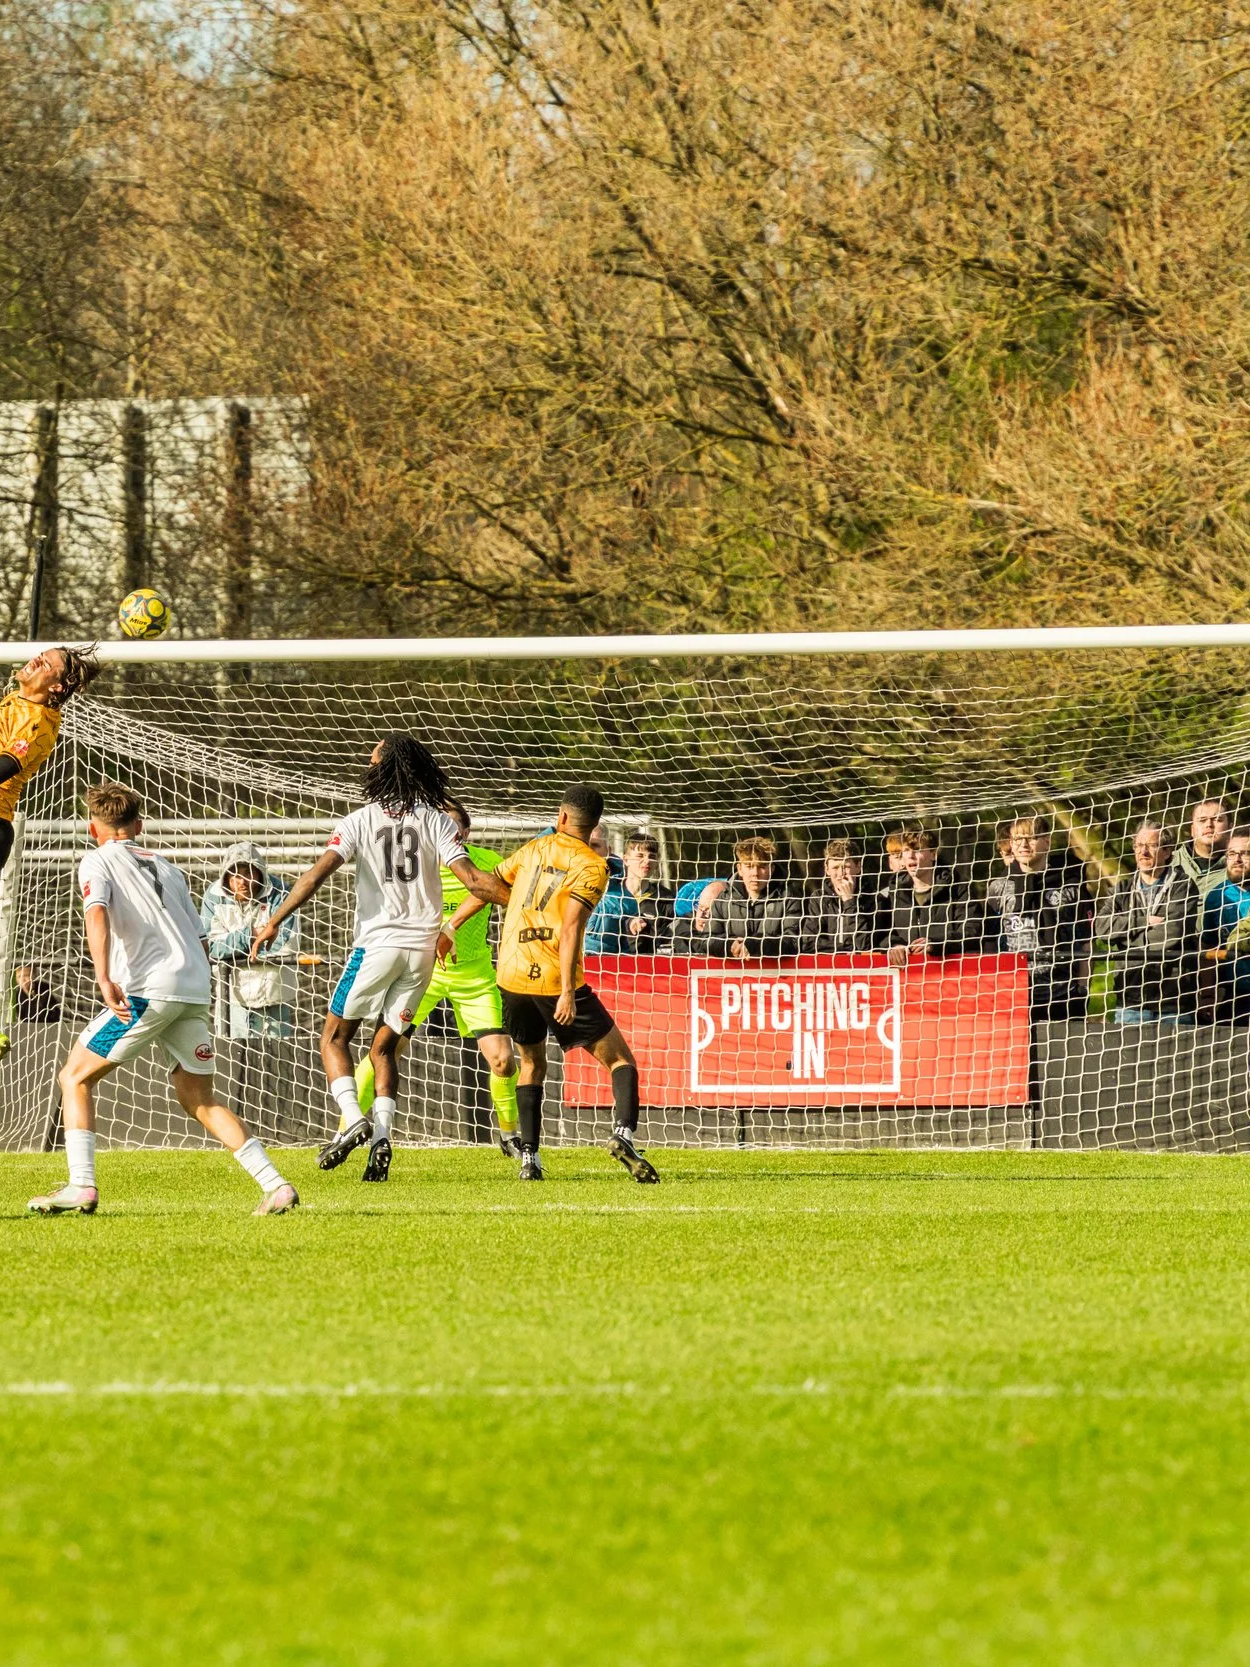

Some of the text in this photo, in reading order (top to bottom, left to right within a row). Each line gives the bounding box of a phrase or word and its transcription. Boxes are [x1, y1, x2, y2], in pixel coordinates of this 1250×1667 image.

[374, 825, 420, 883] 13
[133, 855, 167, 909] 7
[521, 863, 567, 912] 17
[721, 982, 870, 1030] PITCHING
[793, 1031, 825, 1079] IN
